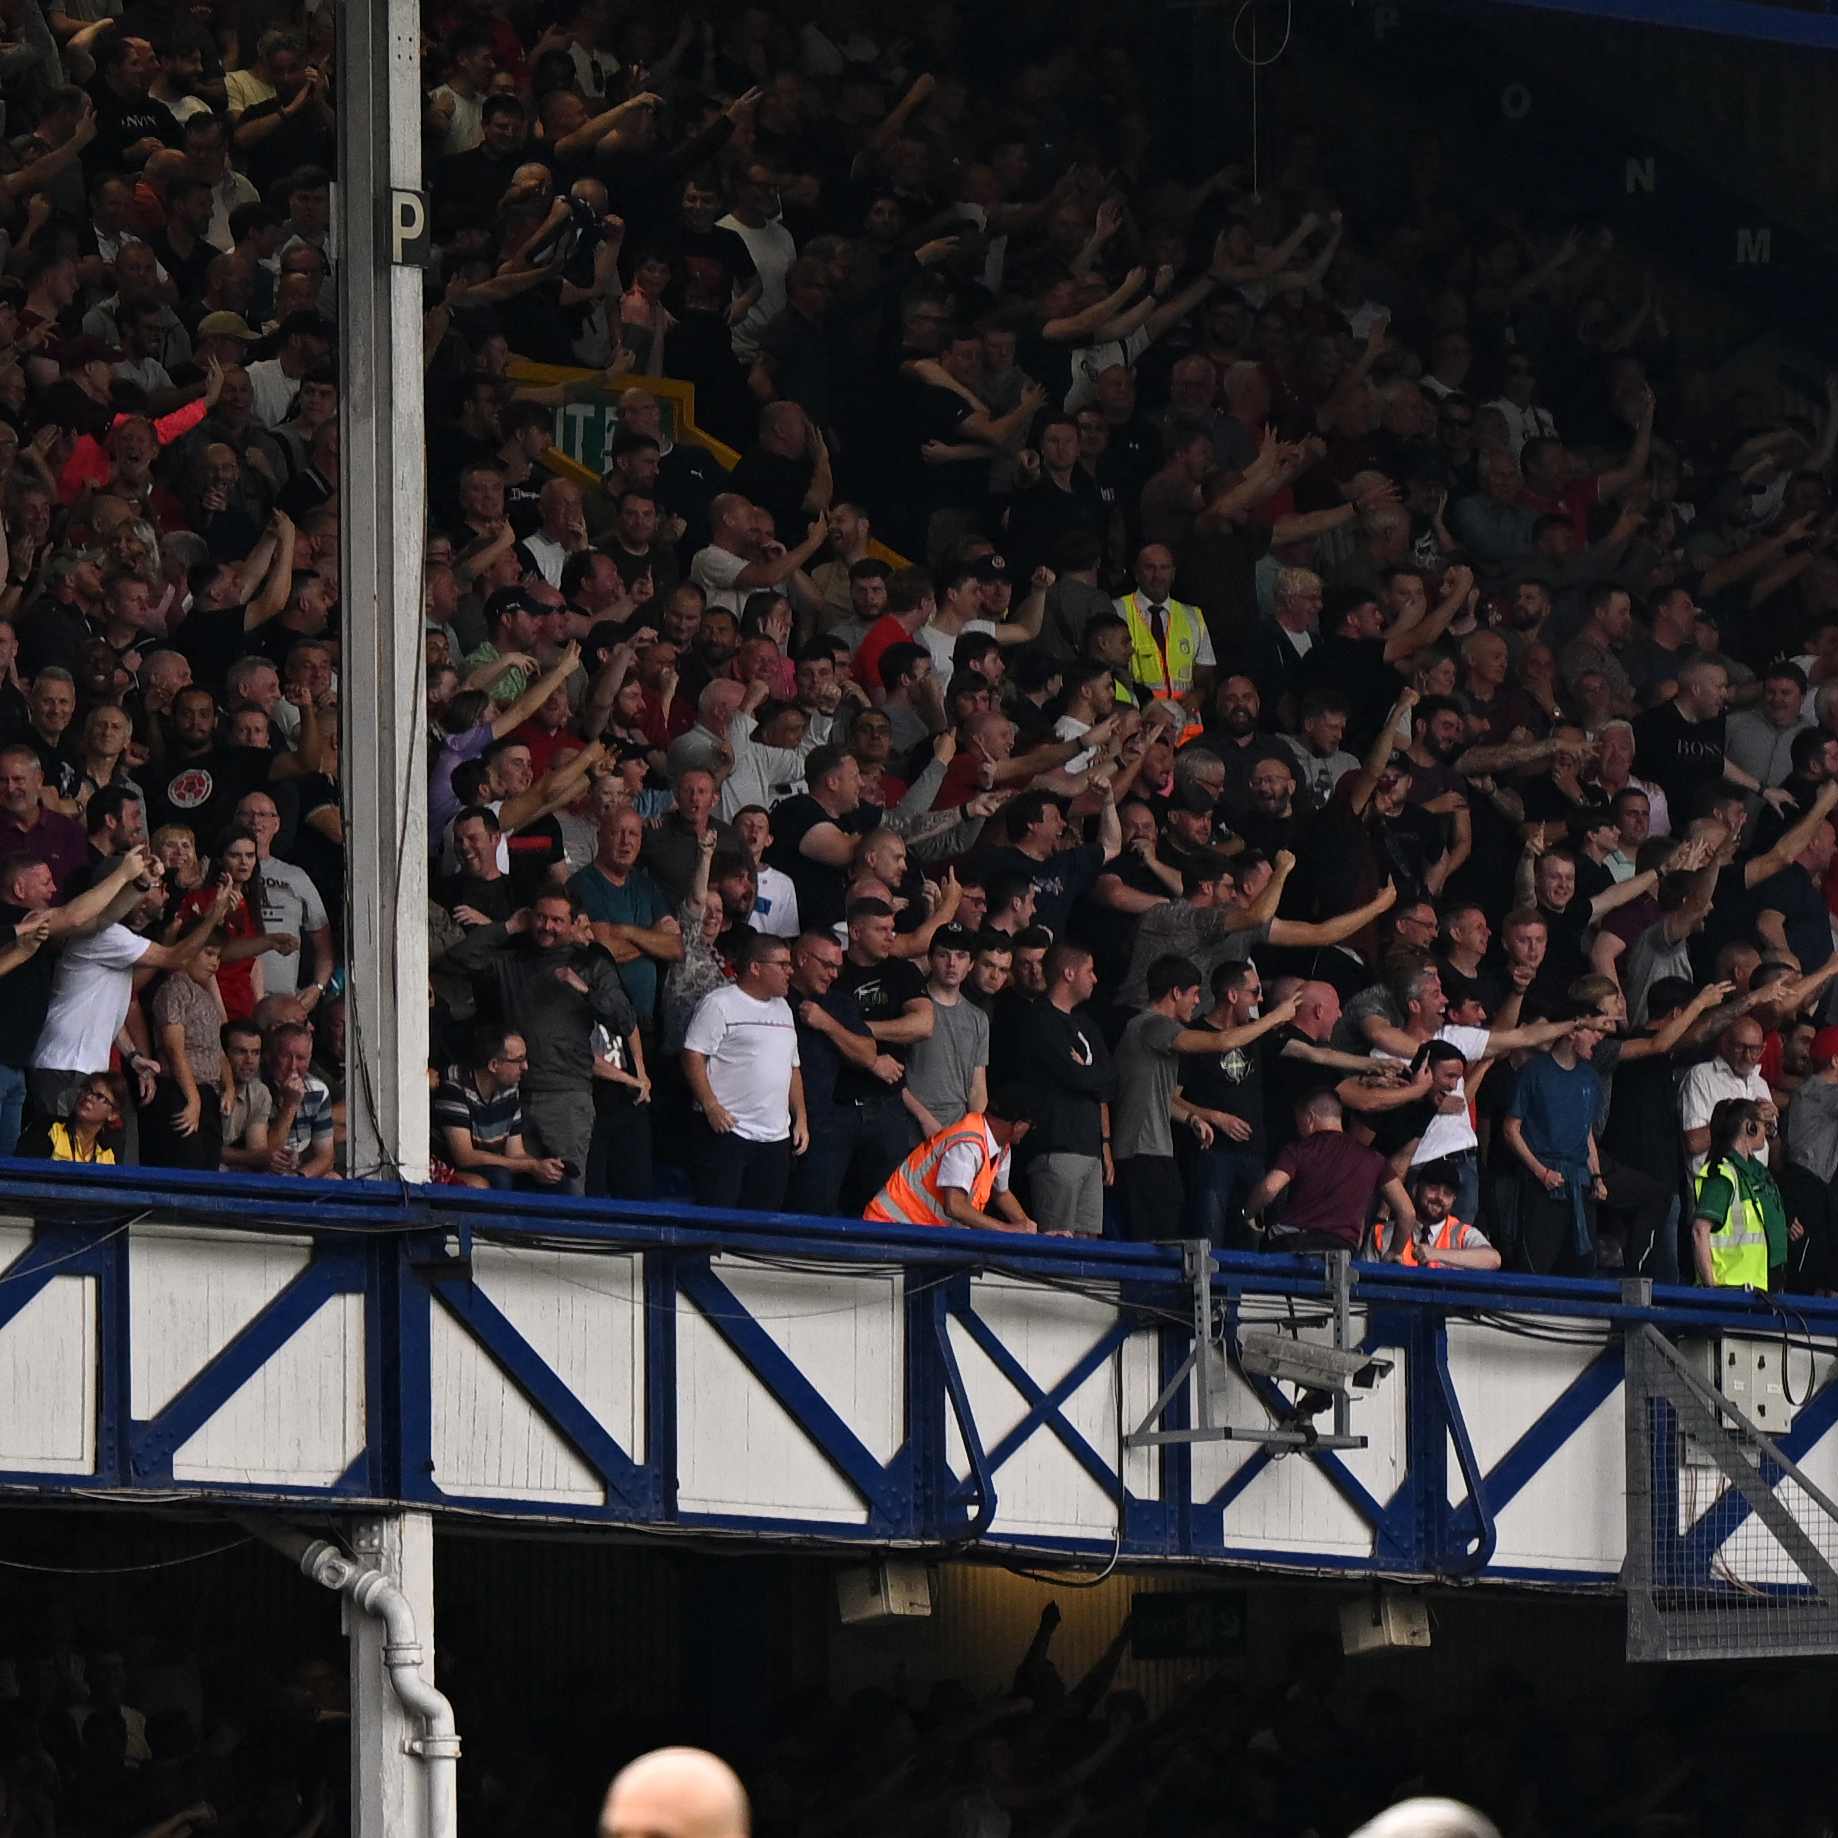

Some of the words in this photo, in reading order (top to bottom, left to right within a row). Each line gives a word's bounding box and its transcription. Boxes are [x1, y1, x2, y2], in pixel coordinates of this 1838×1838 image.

[1625, 156, 1655, 193] N
[391, 190, 425, 263] P
[1736, 229, 1771, 263] M
